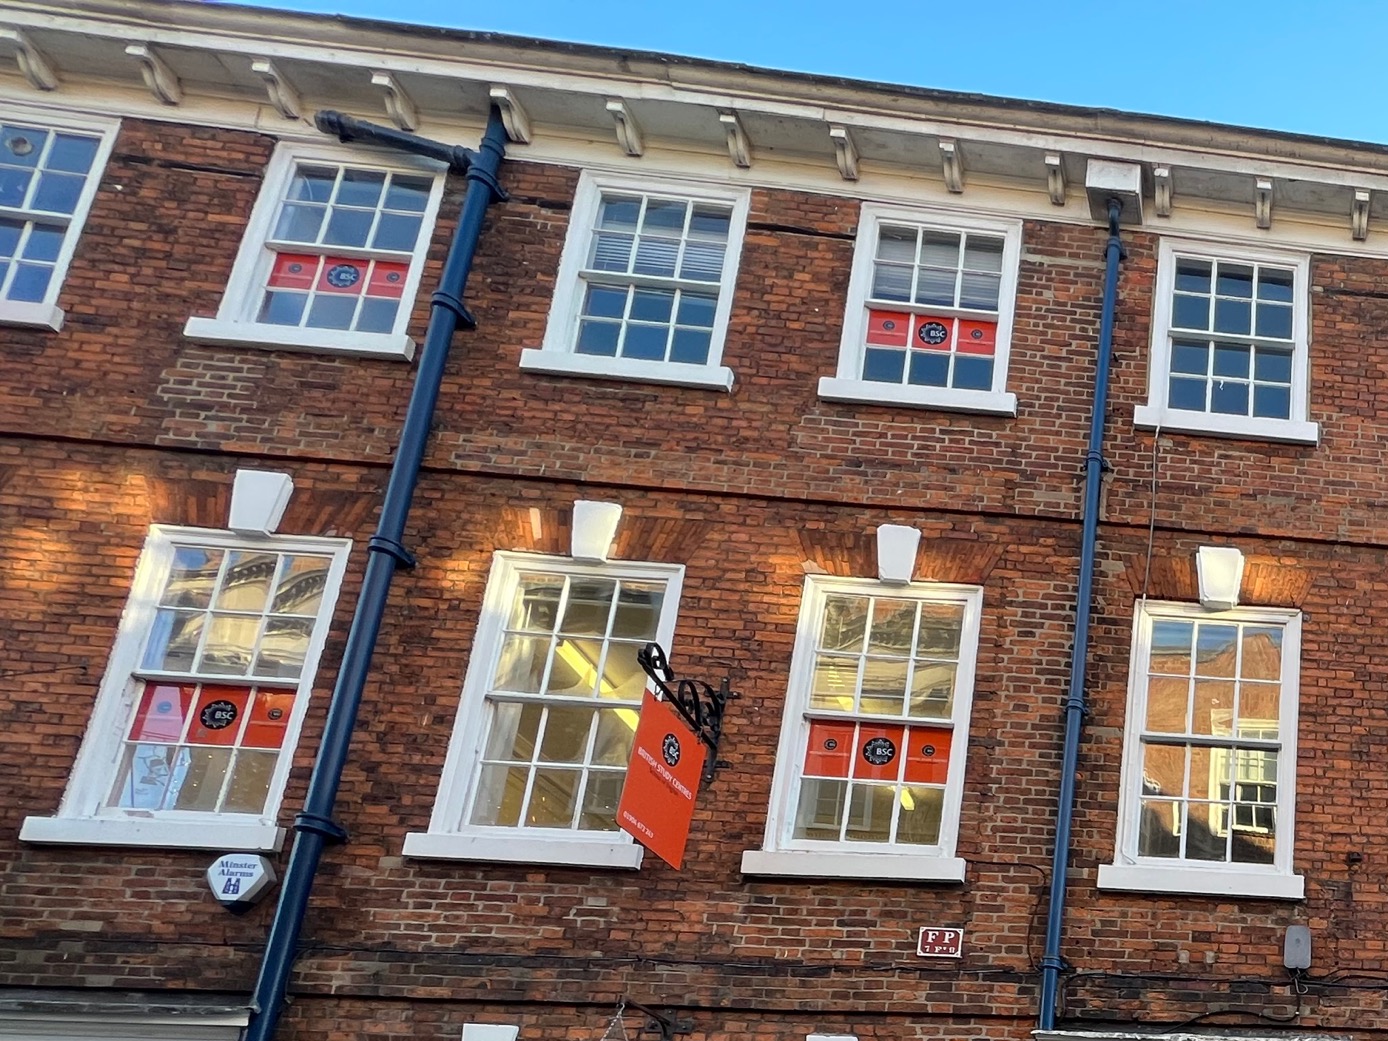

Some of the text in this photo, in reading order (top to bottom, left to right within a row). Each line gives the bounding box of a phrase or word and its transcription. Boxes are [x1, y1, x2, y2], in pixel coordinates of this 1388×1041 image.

[340, 272, 356, 281] BSC
[930, 330, 945, 338] BSC
[215, 710, 234, 720] BSC
[876, 747, 893, 756] BSC
[219, 860, 258, 870] Minster
[218, 869, 254, 878] Alarms
